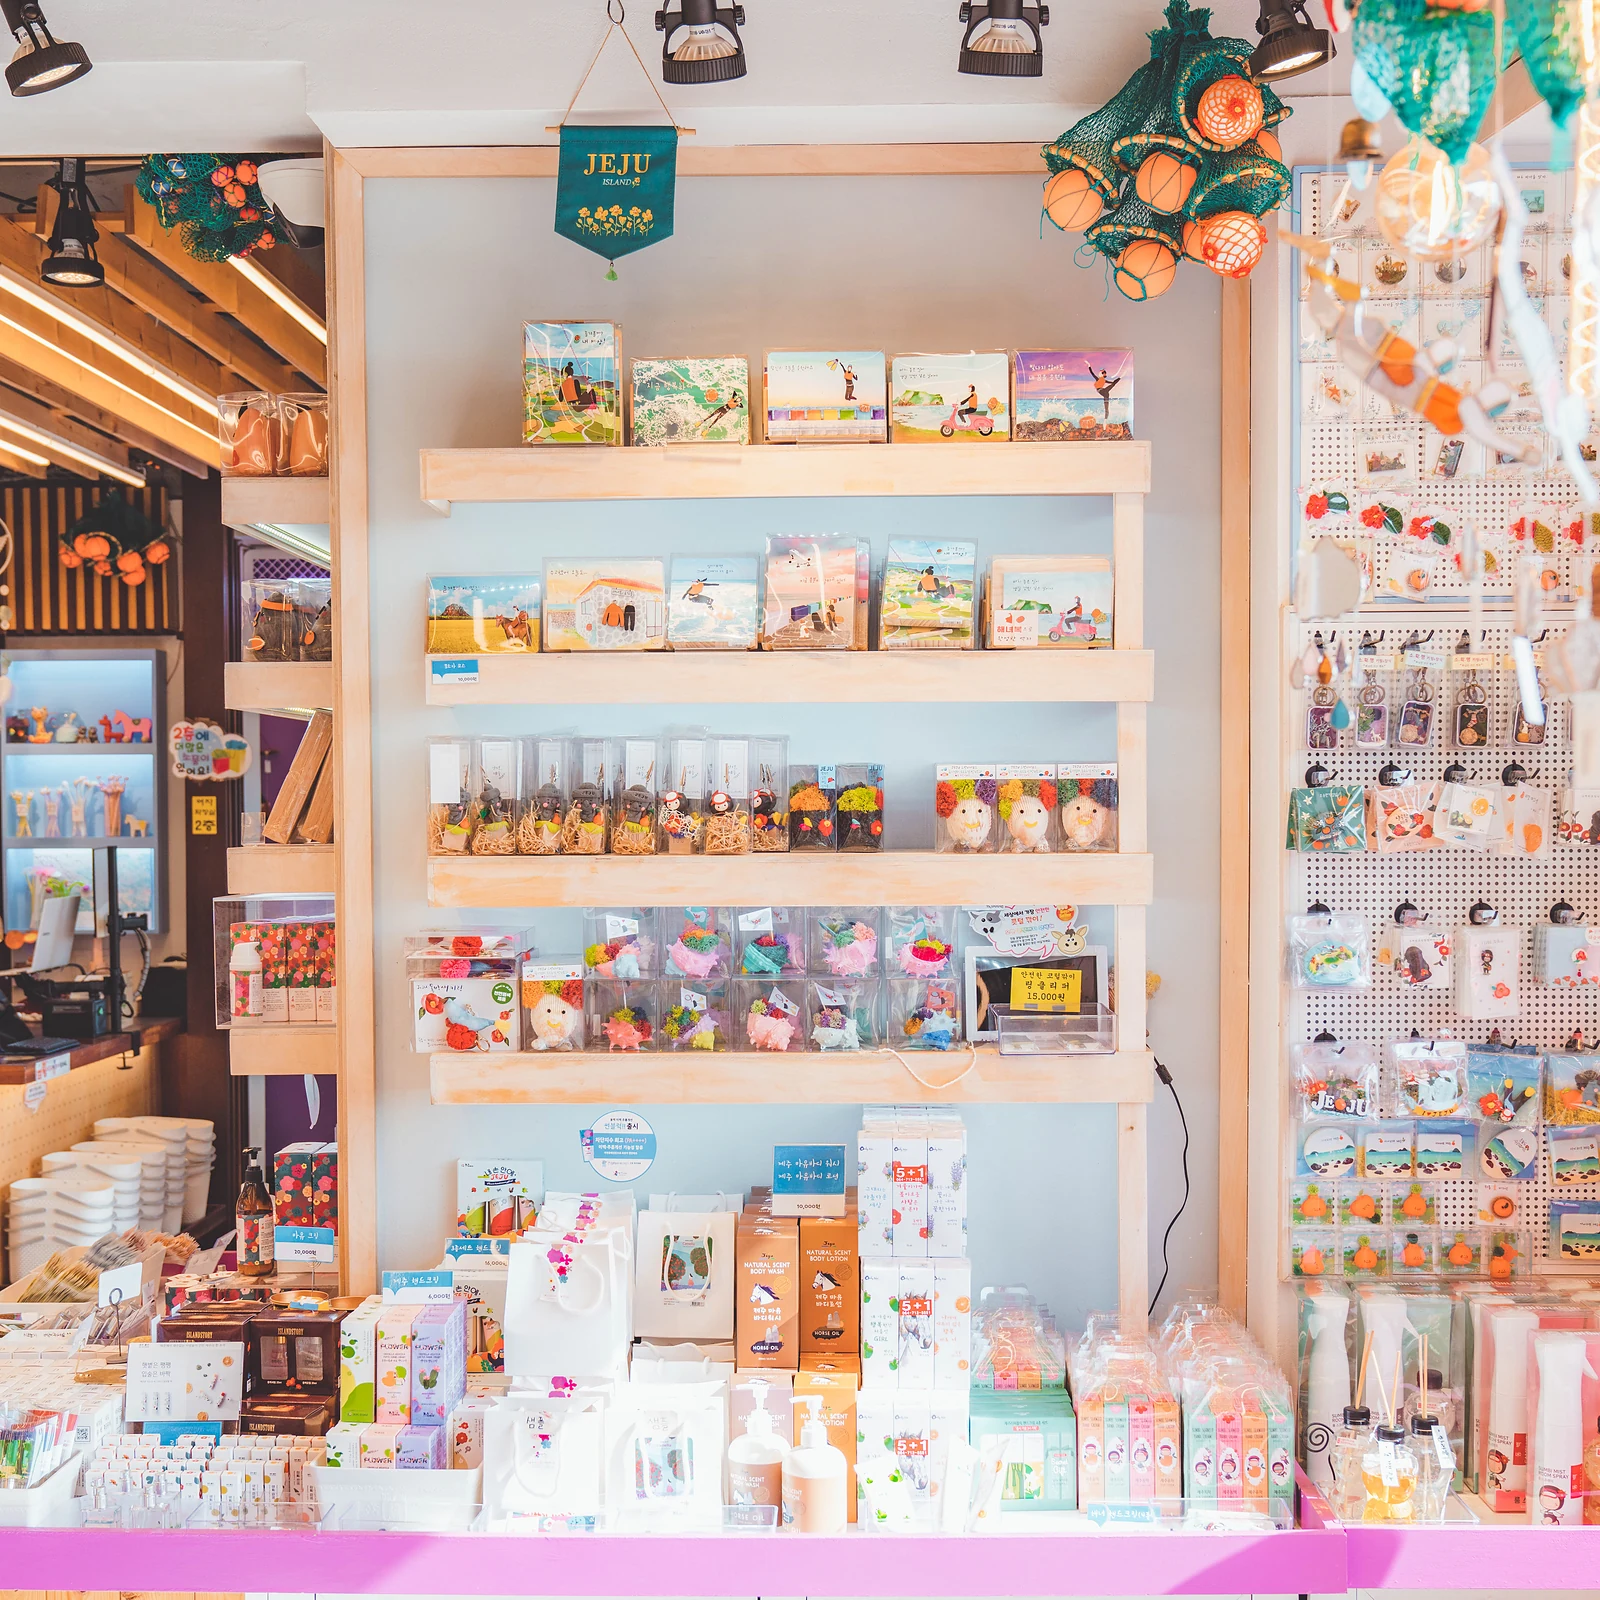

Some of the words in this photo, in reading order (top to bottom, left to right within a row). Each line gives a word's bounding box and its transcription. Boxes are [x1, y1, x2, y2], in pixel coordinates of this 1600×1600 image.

[583, 153, 651, 175] JEJU
[602, 178, 631, 186] ISLAND
[173, 726, 210, 741] 2층에
[185, 742, 205, 754] 많은
[175, 763, 211, 775] 있어요!
[869, 764, 883, 772] JEJU
[195, 819, 216, 832] 2층
[1020, 971, 1043, 980] 안전한
[1027, 992, 1066, 1003] 15.000원
[1432, 1108, 1454, 1117] JEJU
[778, 1160, 793, 1169] 제주
[778, 1171, 793, 1182] 제주
[825, 1172, 839, 1181] 로션
[896, 1167, 925, 1178] 5+1
[308, 1231, 319, 1240] 크림
[450, 1244, 473, 1252] 3종세트
[411, 1275, 440, 1285] 핸드크림
[901, 1300, 931, 1311] 5+1
[186, 1331, 213, 1339] ISLANDSTORY
[277, 1328, 304, 1336] ISLANDSTORY
[380, 1343, 409, 1351] FLOWER
[414, 1343, 443, 1351] FLOWER
[249, 1423, 276, 1432] ISLANDSTORY
[897, 1439, 928, 1451] 5+1
